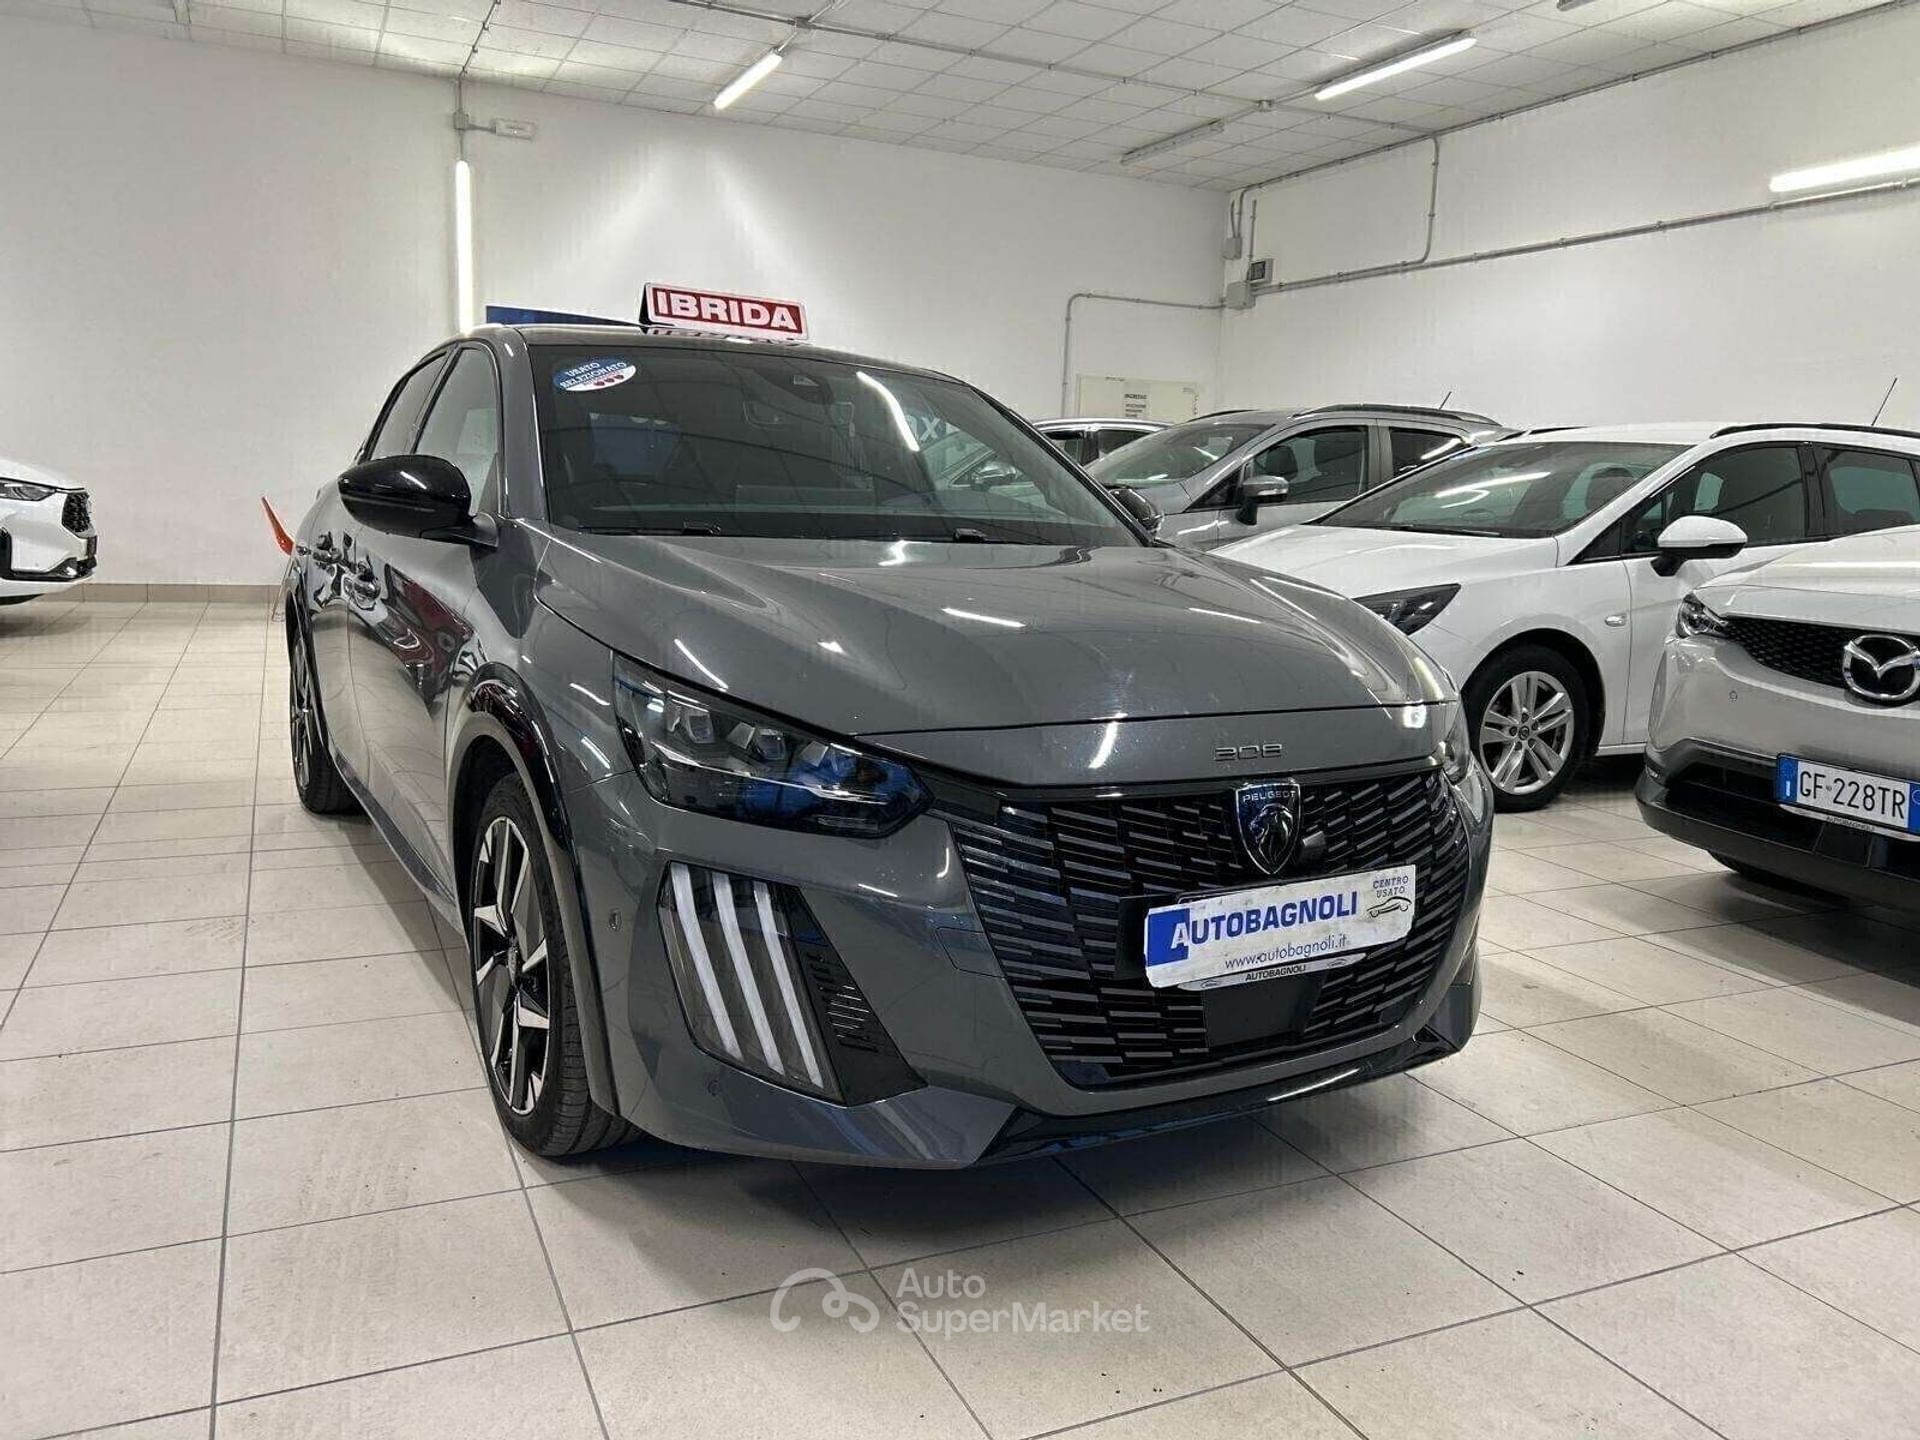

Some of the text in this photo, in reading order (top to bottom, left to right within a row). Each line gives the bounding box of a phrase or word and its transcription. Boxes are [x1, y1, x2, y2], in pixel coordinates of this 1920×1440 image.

[655, 291, 798, 331] IBRIDA
[1214, 743, 1282, 762] 208
[1242, 790, 1297, 803] PEUGEOT
[1373, 874, 1410, 890] CENTRO
[1376, 887, 1406, 899] USATO
[1170, 890, 1358, 950] AUTOBAGNOLI
[1224, 933, 1348, 970] www.autobagnoli.it
[1245, 963, 1307, 983] AUTOBAGNOLI
